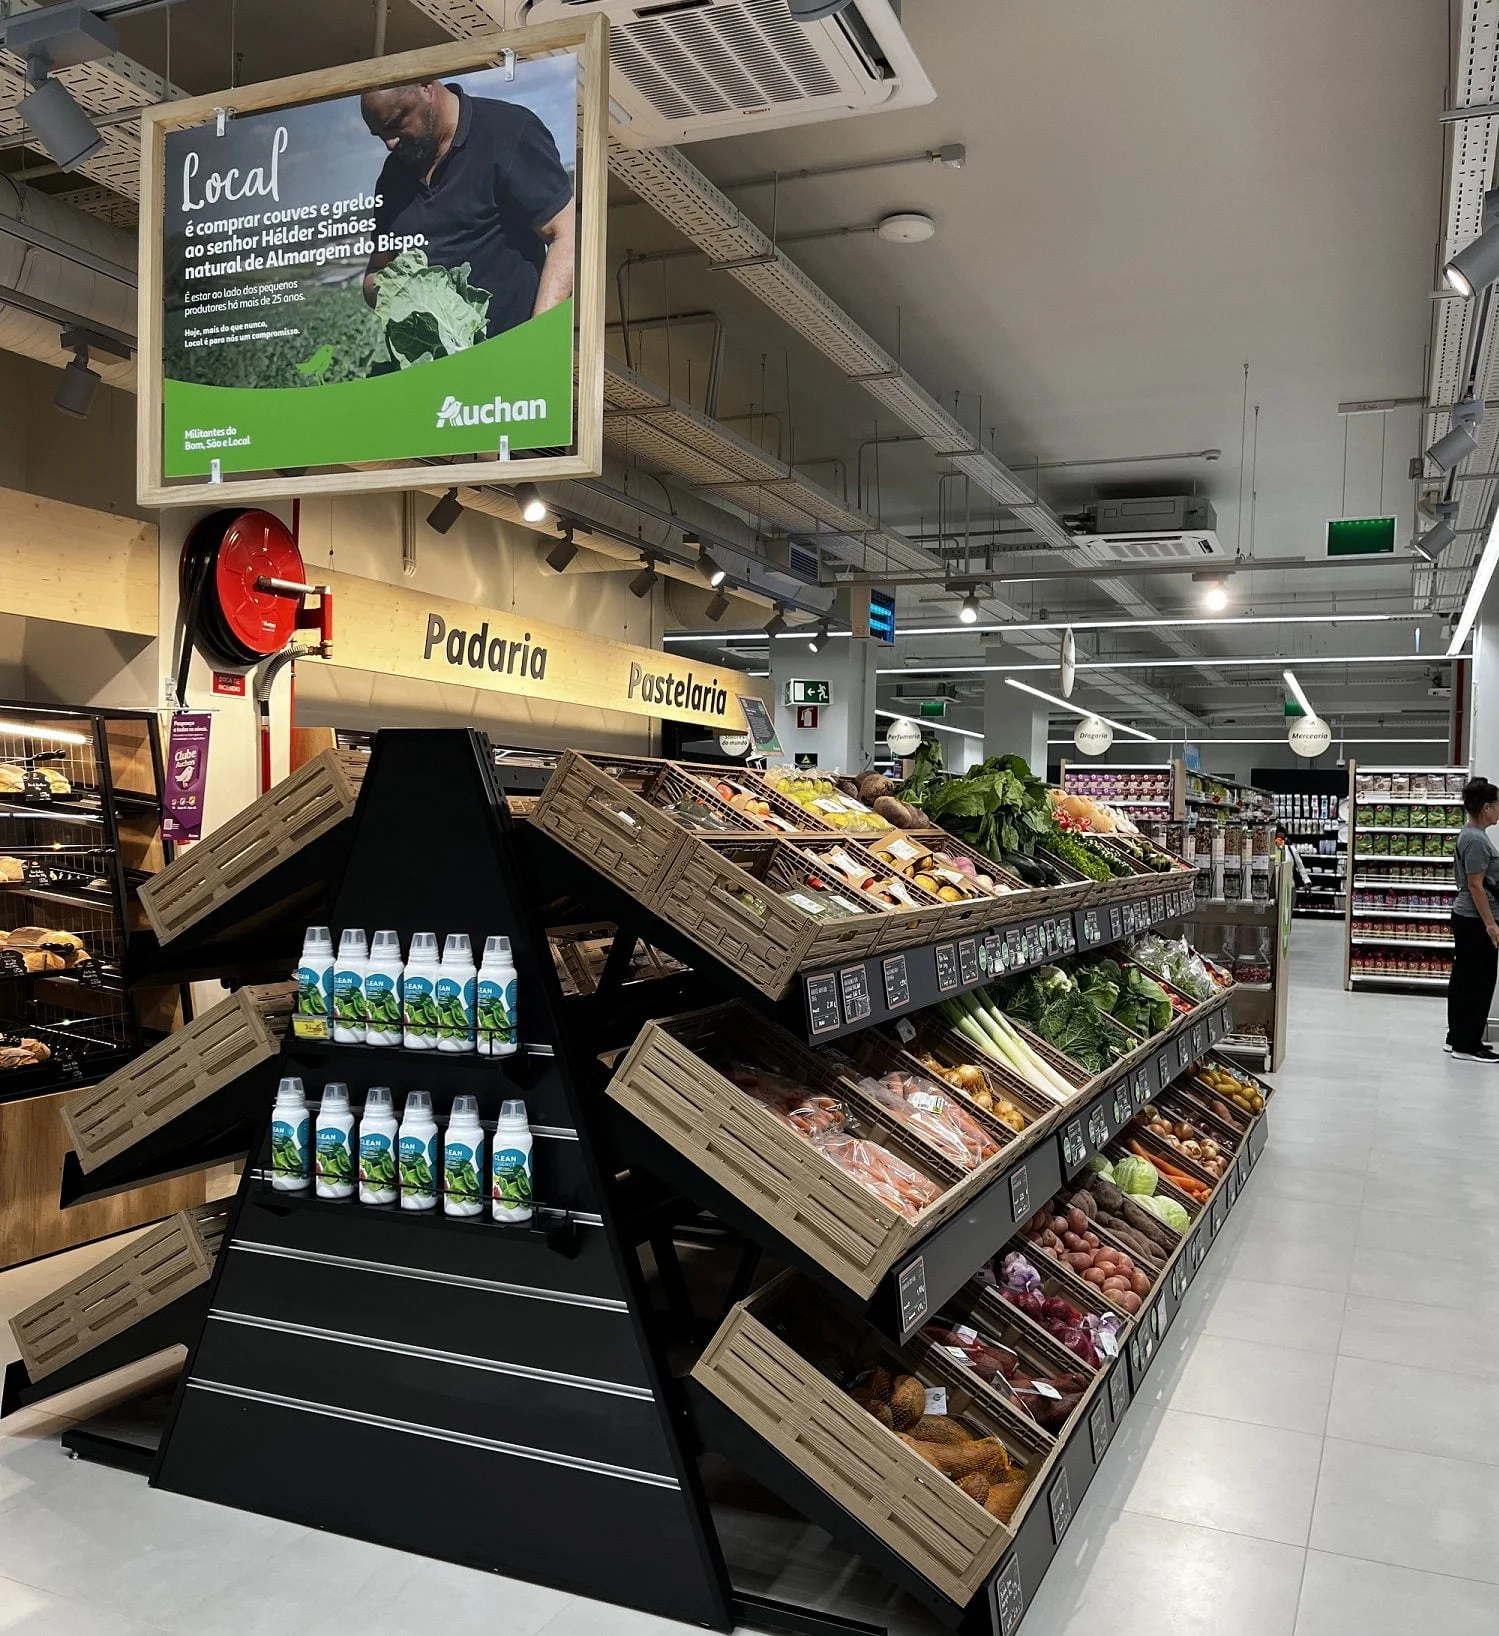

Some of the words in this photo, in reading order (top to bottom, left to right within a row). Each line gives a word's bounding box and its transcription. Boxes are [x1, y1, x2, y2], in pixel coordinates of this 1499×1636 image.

[182, 126, 288, 211] Local
[185, 220, 194, 237] é
[196, 214, 260, 235] comprar
[263, 205, 318, 225] couves
[320, 203, 330, 216] e
[332, 192, 384, 219] grelos
[185, 244, 204, 258] ao
[206, 235, 259, 256] senhor
[262, 225, 314, 247] Hélder
[318, 216, 376, 238] Simões
[185, 256, 242, 280] natural
[244, 254, 264, 270] de
[266, 244, 350, 268] Almargem
[354, 237, 375, 256] do
[378, 232, 428, 254] Bispo.
[184, 291, 190, 302] É
[192, 292, 210, 302] estar
[224, 287, 242, 298] lado
[243, 285, 258, 295] dos
[259, 280, 298, 296] pequenos
[184, 303, 226, 318] produtores
[228, 300, 238, 310] há
[240, 297, 259, 308] mais
[260, 296, 270, 306] de
[272, 294, 282, 304] 25
[284, 293, 306, 303] anos.
[184, 328, 202, 338] Hoje,
[203, 325, 219, 335] mais
[230, 323, 243, 332] que
[244, 321, 268, 329] nunca,
[184, 338, 203, 348] Local
[204, 336, 208, 346] é
[210, 336, 225, 346] para
[226, 334, 238, 343] nós
[240, 333, 250, 341] um
[252, 327, 300, 340] compromisso.
[436, 396, 546, 428] Auchan
[184, 428, 225, 440] Militantes
[226, 426, 236, 436] do
[184, 441, 206, 450] Bom,
[206, 438, 221, 448] São
[228, 435, 250, 446] Local
[424, 613, 548, 680] Padaria
[628, 662, 727, 715] Pastelaria
[175, 749, 196, 762] Clube
